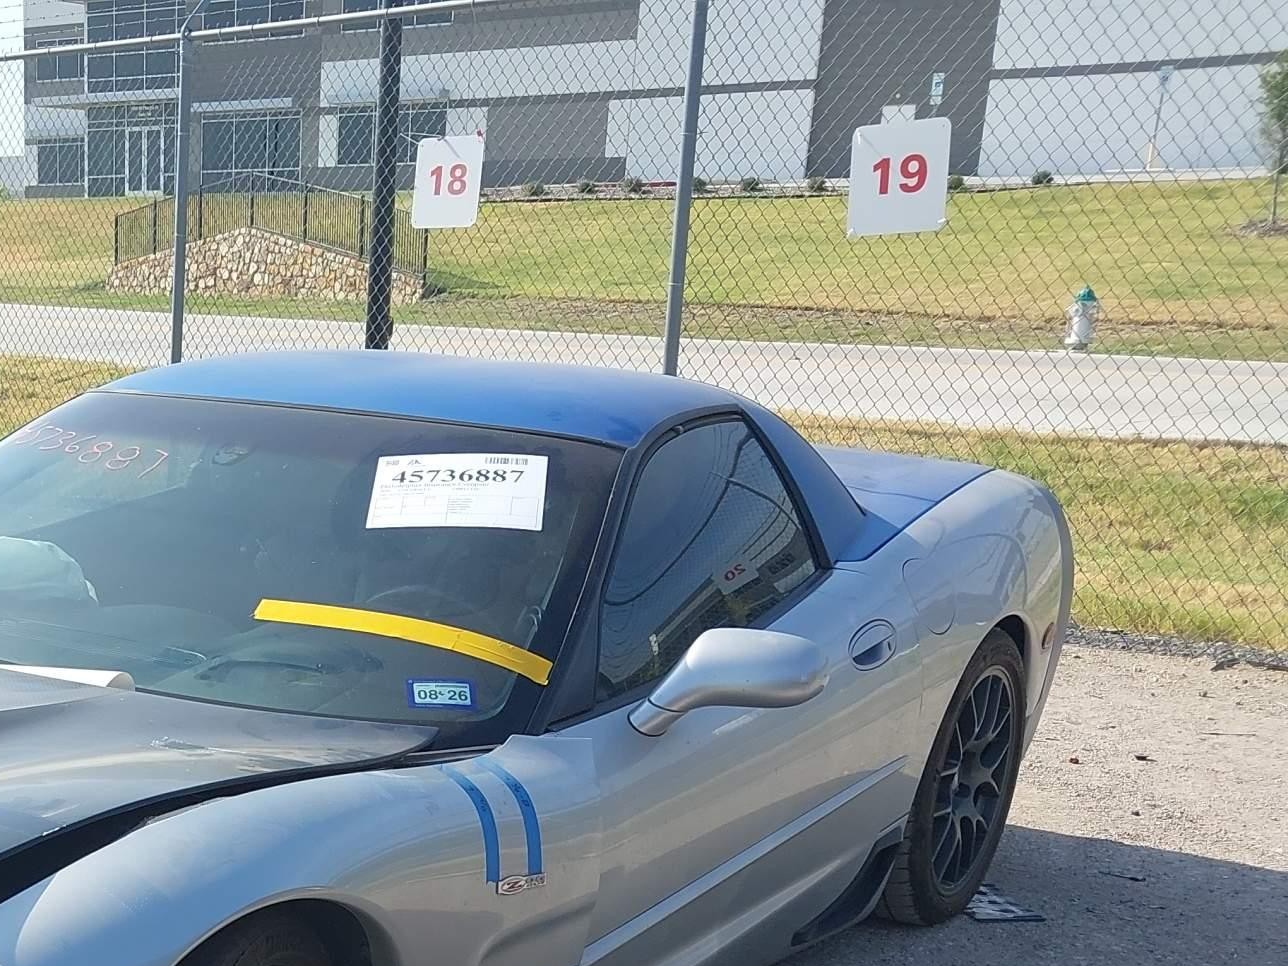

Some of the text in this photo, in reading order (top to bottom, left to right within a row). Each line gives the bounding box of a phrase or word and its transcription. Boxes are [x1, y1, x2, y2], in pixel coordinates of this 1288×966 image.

[430, 163, 468, 196] 18
[872, 153, 928, 196] 19
[391, 468, 525, 483] 45736887
[417, 689, 468, 701] 08 26
